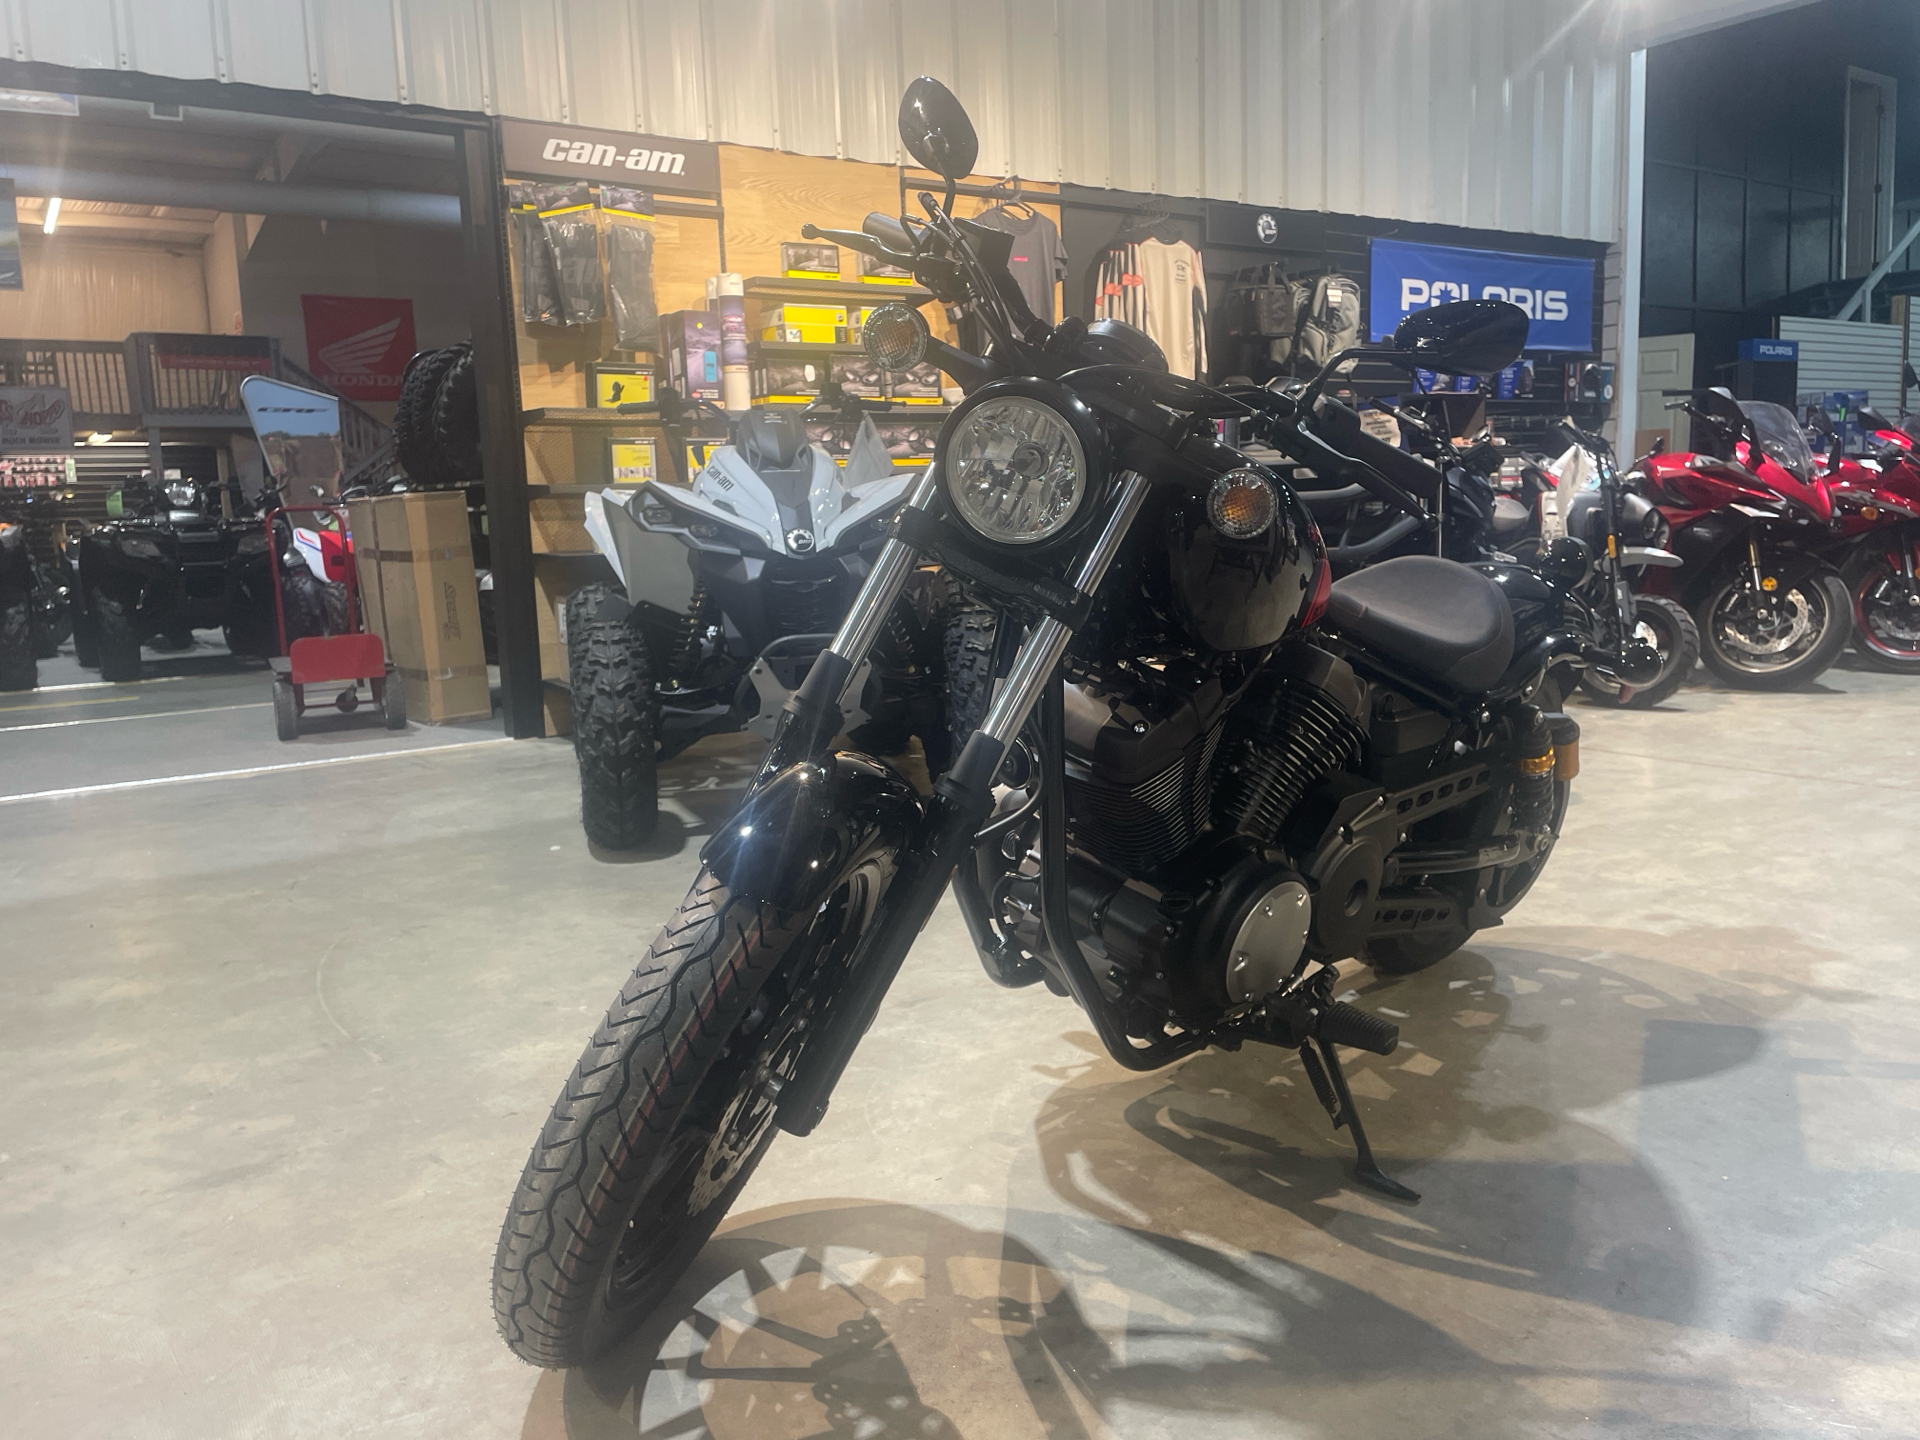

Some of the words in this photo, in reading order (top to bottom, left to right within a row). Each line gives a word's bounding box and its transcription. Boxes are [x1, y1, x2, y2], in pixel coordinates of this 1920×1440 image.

[543, 138, 686, 176] can-am
[1760, 344, 1793, 356] POLARIS
[706, 465, 735, 492] can-am
